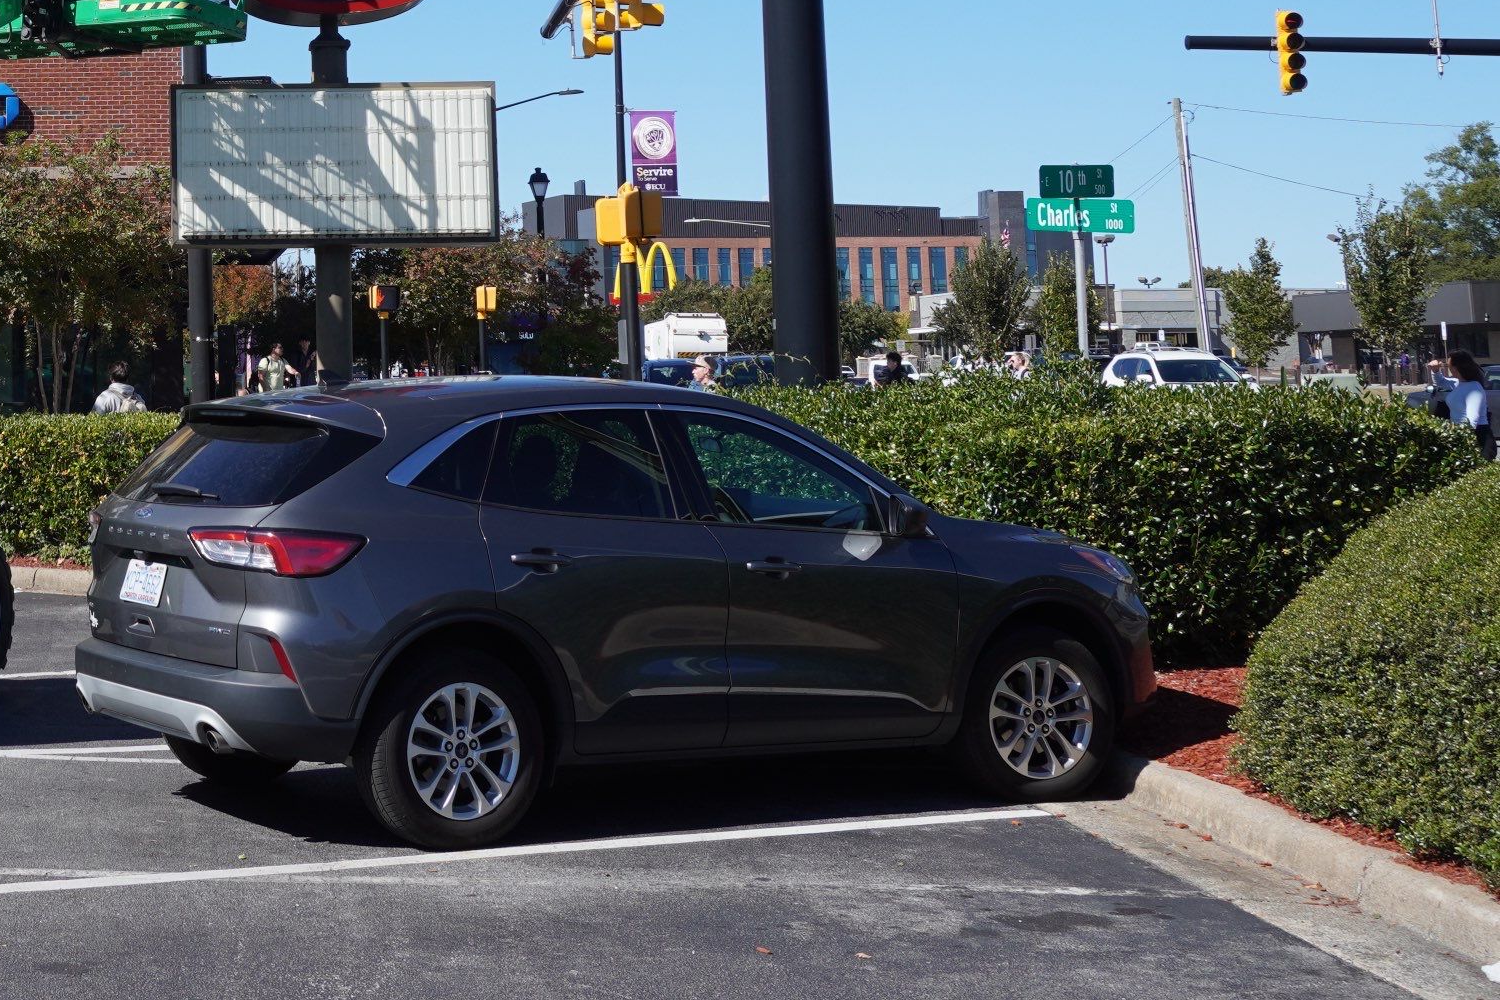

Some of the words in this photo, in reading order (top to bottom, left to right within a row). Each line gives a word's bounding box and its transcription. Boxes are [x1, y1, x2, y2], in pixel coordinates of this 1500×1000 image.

[636, 166, 674, 177] Servire
[1044, 176, 1050, 187] E
[1096, 168, 1103, 179] St
[1094, 184, 1106, 195] 500
[1037, 202, 1091, 228] Charles
[1110, 202, 1118, 213] St
[1105, 218, 1124, 230] 1000
